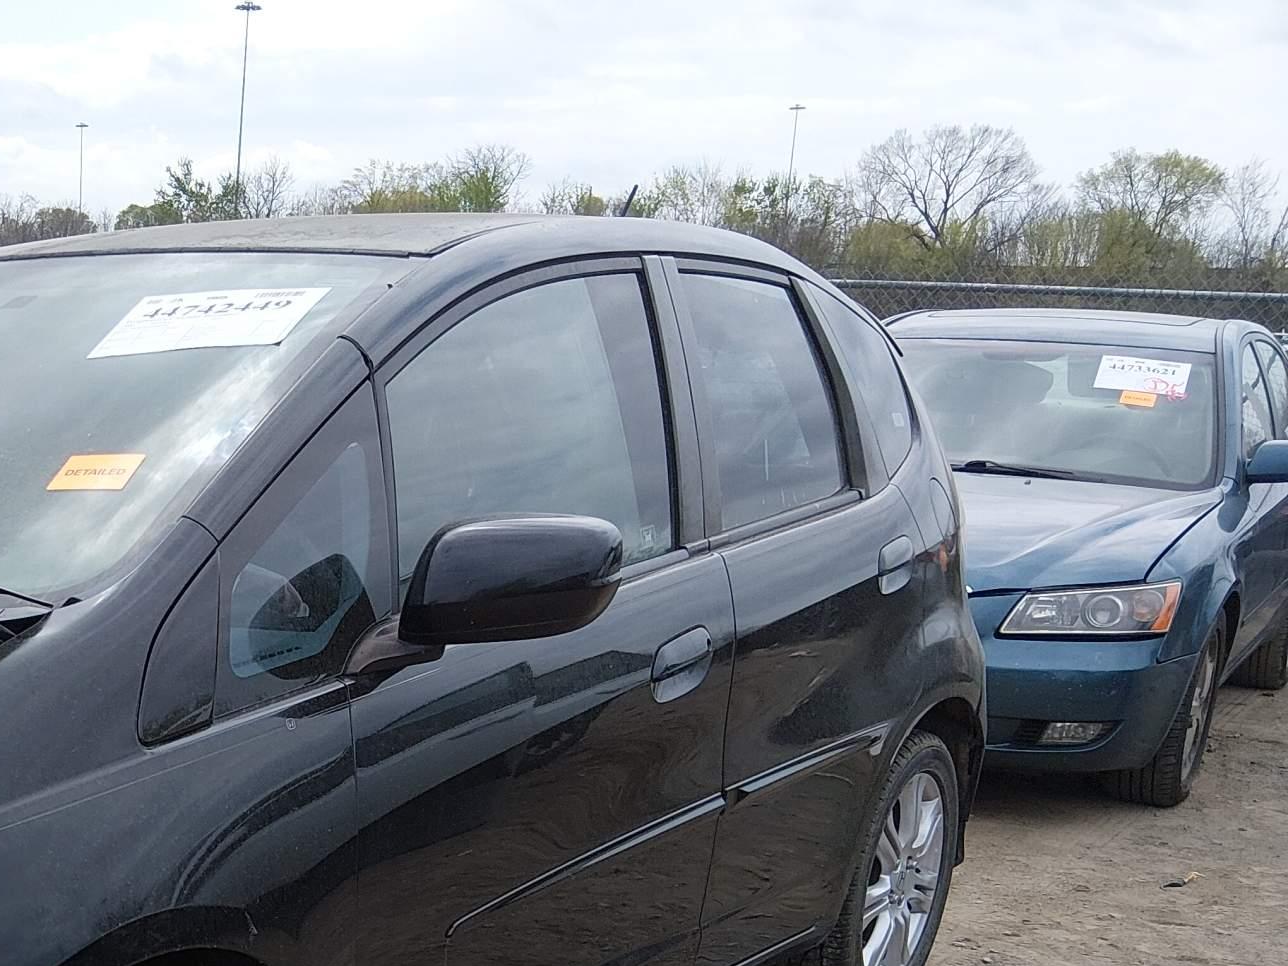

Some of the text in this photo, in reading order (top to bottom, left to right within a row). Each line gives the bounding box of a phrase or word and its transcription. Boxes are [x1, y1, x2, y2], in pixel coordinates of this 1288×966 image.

[143, 300, 293, 319] 44742449
[1108, 363, 1177, 376] 44733621
[64, 467, 127, 477] DETAILED
